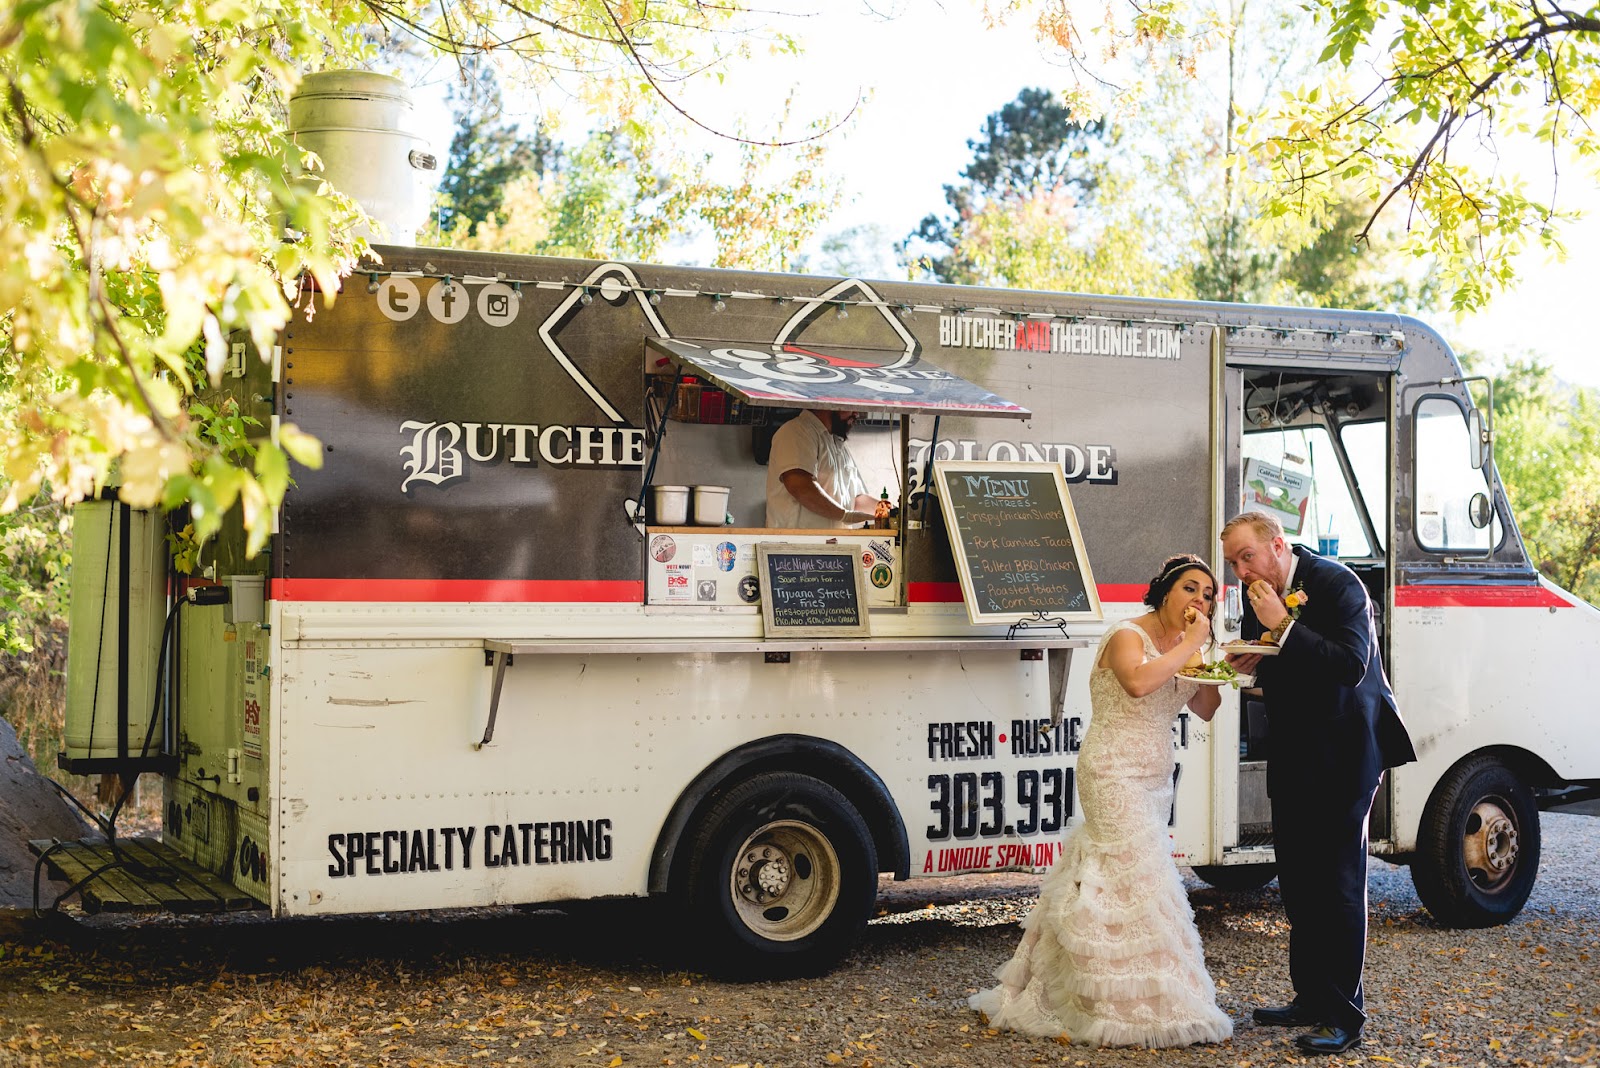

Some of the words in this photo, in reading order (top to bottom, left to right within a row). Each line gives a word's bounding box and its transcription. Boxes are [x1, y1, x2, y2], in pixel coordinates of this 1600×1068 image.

[939, 315, 1181, 360] BUTCHERANDTHEBLONDE.COM
[962, 475, 1030, 498] MENU
[1283, 476, 1300, 487] Apples
[1000, 510, 1034, 521] Chicken
[972, 535, 1000, 549] Pork
[1001, 536, 1041, 549] Carnitas
[1041, 535, 1072, 548] Tacos
[773, 557, 792, 571] Late
[791, 557, 815, 577] Night
[816, 559, 844, 571] Snack
[1014, 559, 1039, 573] BBQ
[1039, 558, 1076, 572] Chicken
[777, 574, 797, 583] Save
[773, 587, 815, 604] Tijuana
[816, 588, 852, 600] Street
[986, 583, 1031, 597] Roasted
[799, 598, 826, 608] Fries
[1001, 596, 1026, 610] Corn
[1028, 596, 1067, 606] Salad
[927, 720, 995, 760] FRESH
[1011, 716, 1083, 757] RUSTIC
[328, 825, 476, 878] SPECIALTY
[484, 818, 613, 868] CATERING
[923, 849, 934, 874] A
[937, 845, 994, 873] UNIQUE
[995, 843, 1033, 868] SPIN
[1034, 842, 1054, 867] ON
